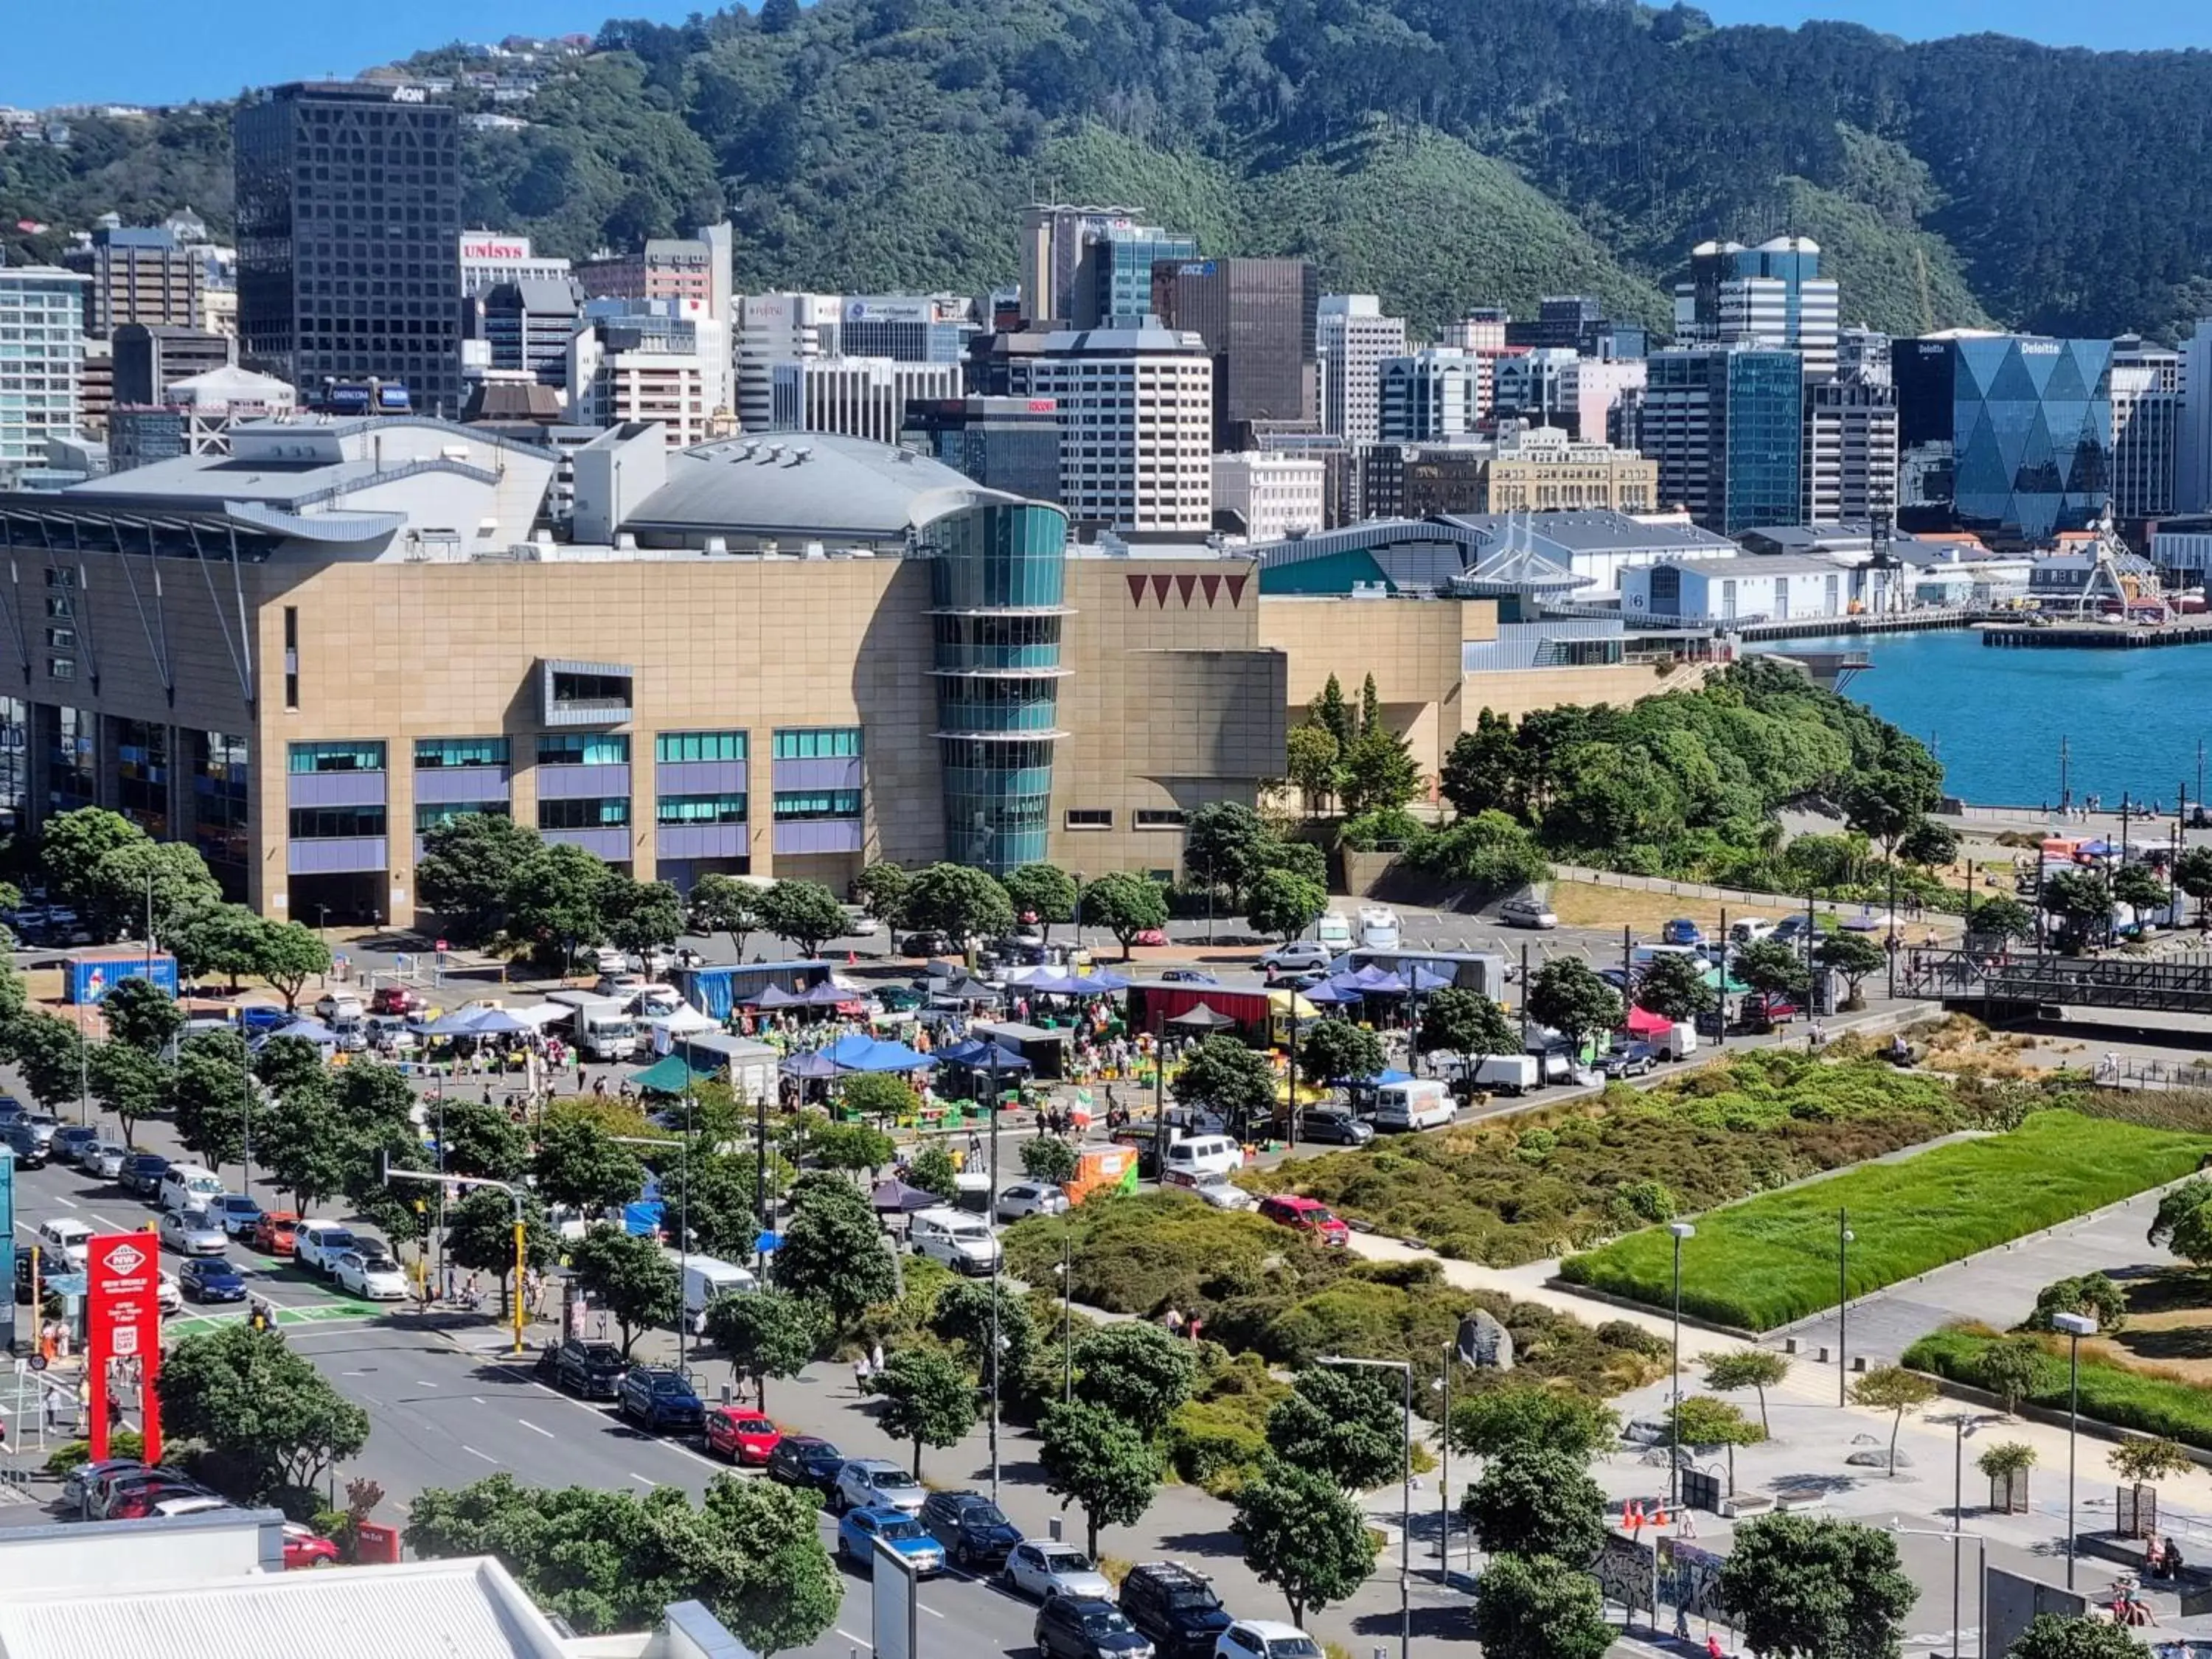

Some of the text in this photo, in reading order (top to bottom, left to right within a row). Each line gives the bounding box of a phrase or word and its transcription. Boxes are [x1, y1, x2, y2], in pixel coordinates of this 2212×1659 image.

[392, 86, 425, 102] AON
[464, 240, 522, 259] UNISYS
[1179, 263, 1204, 276] ANZ
[1919, 344, 1944, 354] Deloitte
[2021, 342, 2059, 355] Deloitte
[1633, 594, 1644, 608] 6
[113, 1254, 136, 1265] NW
[101, 1277, 148, 1289] NEW WORLD
